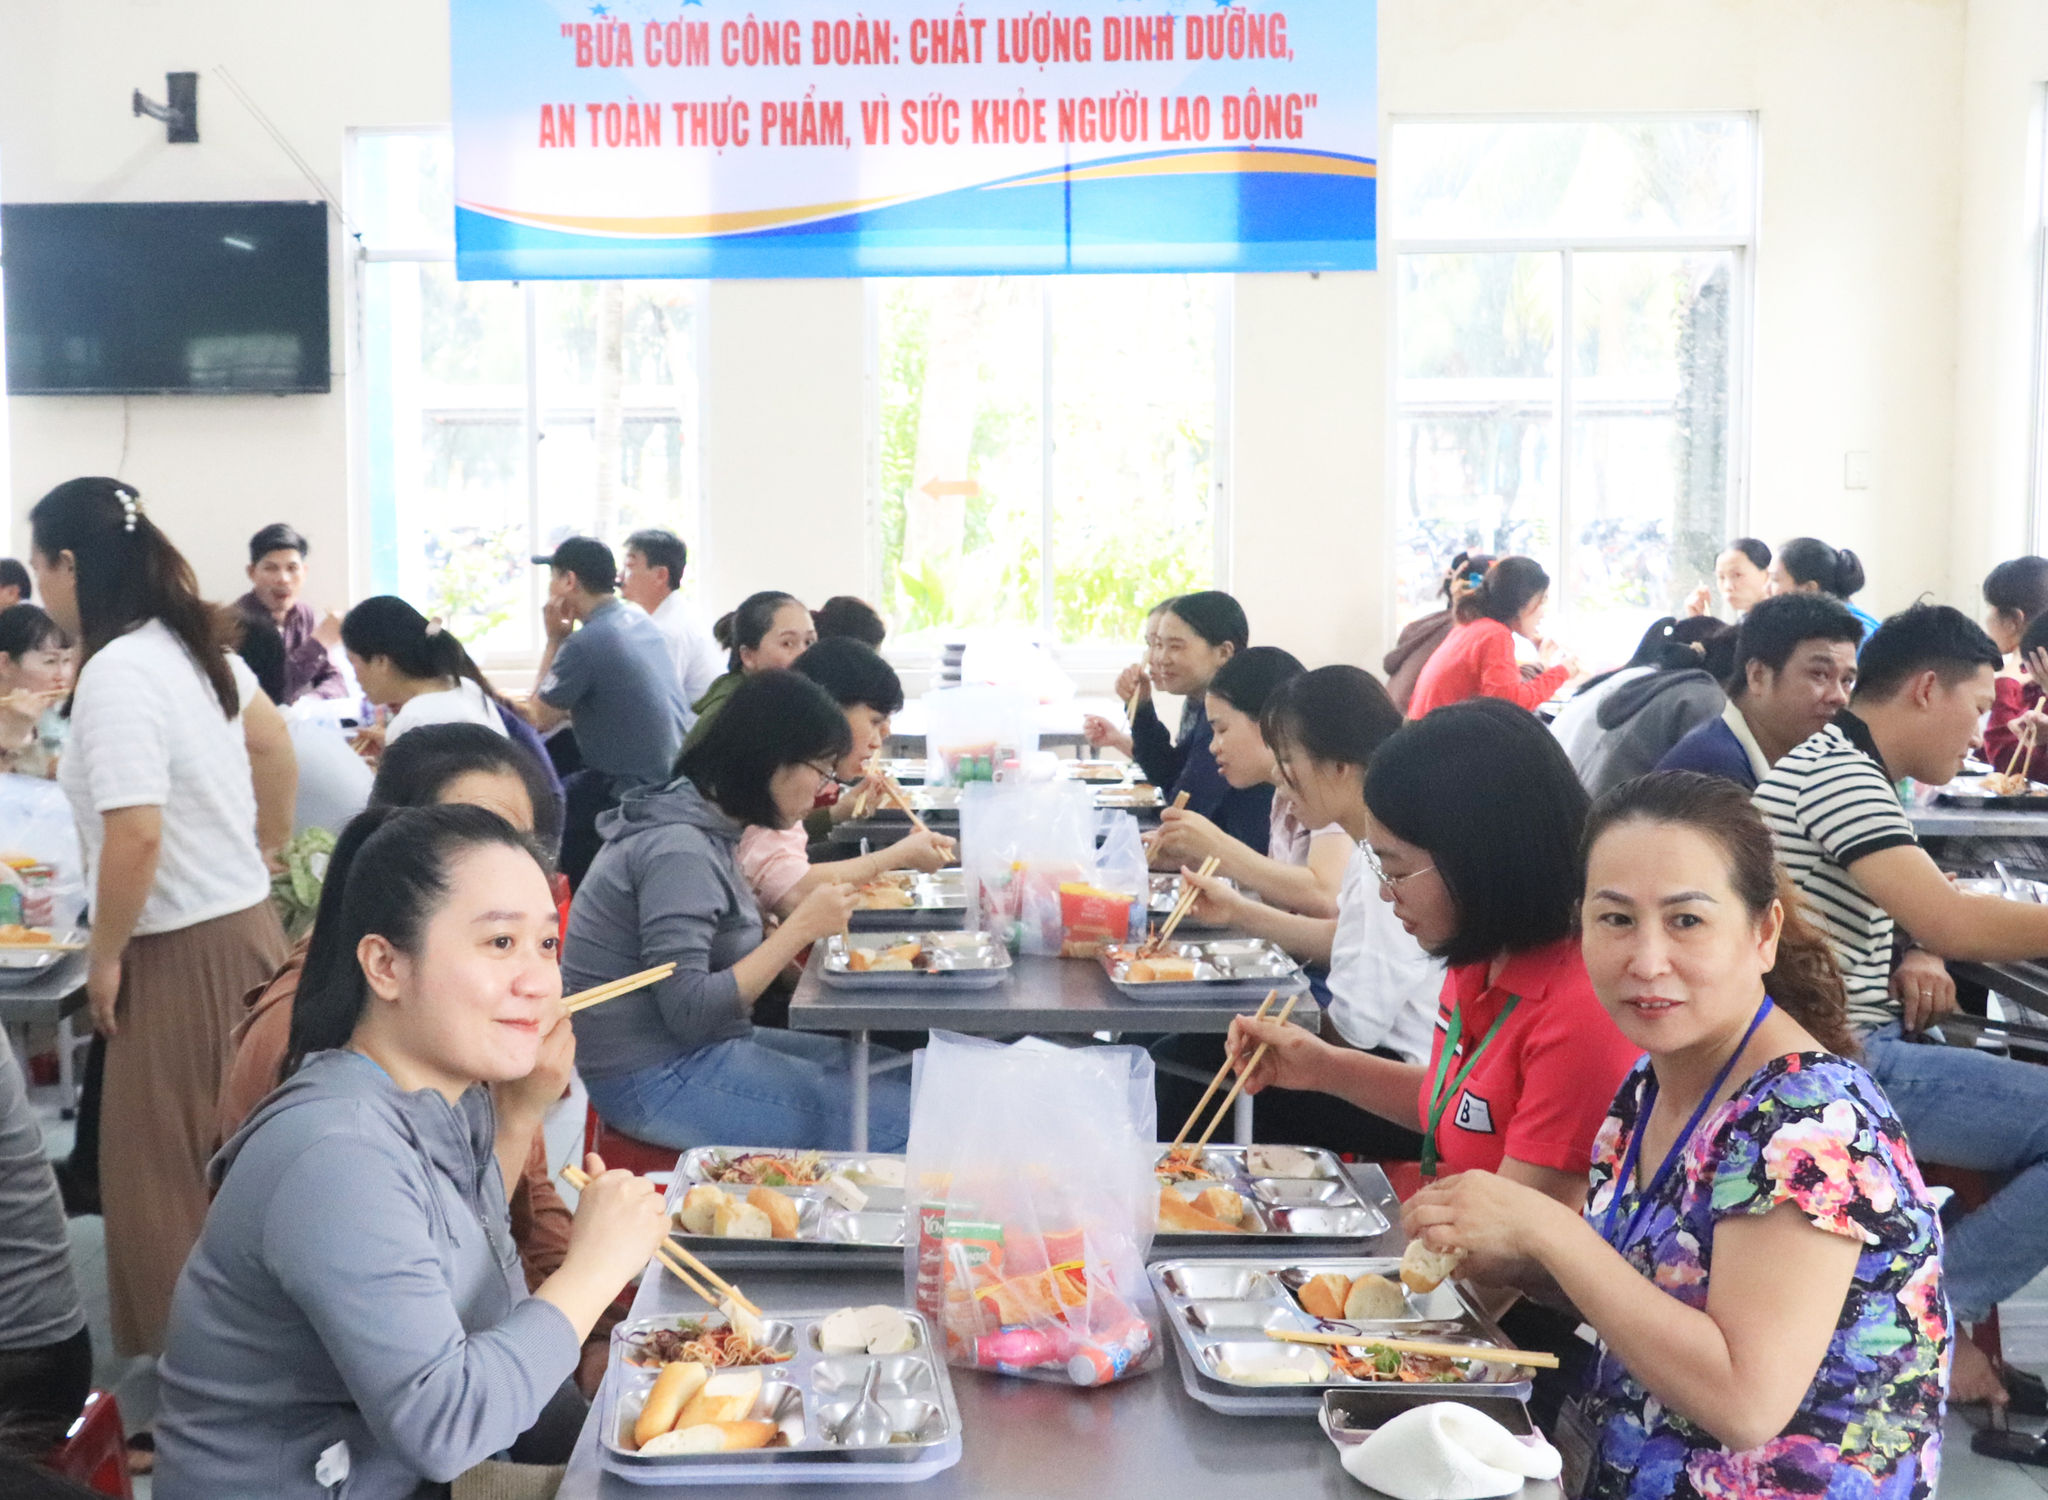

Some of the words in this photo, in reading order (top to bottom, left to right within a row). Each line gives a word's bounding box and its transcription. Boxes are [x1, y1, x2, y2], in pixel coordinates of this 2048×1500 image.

[644, 14, 710, 67] CƠM
[721, 12, 801, 66] CÔNG
[811, 13, 900, 65] ĐOÀN:
[909, 3, 987, 65] CHẤT
[997, 11, 1092, 72] LƯỢNG
[1103, 15, 1175, 62] DINH
[1185, 7, 1294, 62] DƯỠNG,
[538, 103, 576, 149] AN
[586, 96, 661, 148] TOÀN
[671, 95, 750, 155] THỰC
[761, 84, 852, 151] PHẨM,
[860, 93, 890, 146] VÌ
[900, 92, 961, 146] SỨC
[971, 87, 1047, 145] KHỎE
[1057, 89, 1149, 144] NGƯỜI
[1160, 95, 1211, 142] LAO
[1221, 87, 1318, 150] ĐỘNG"
